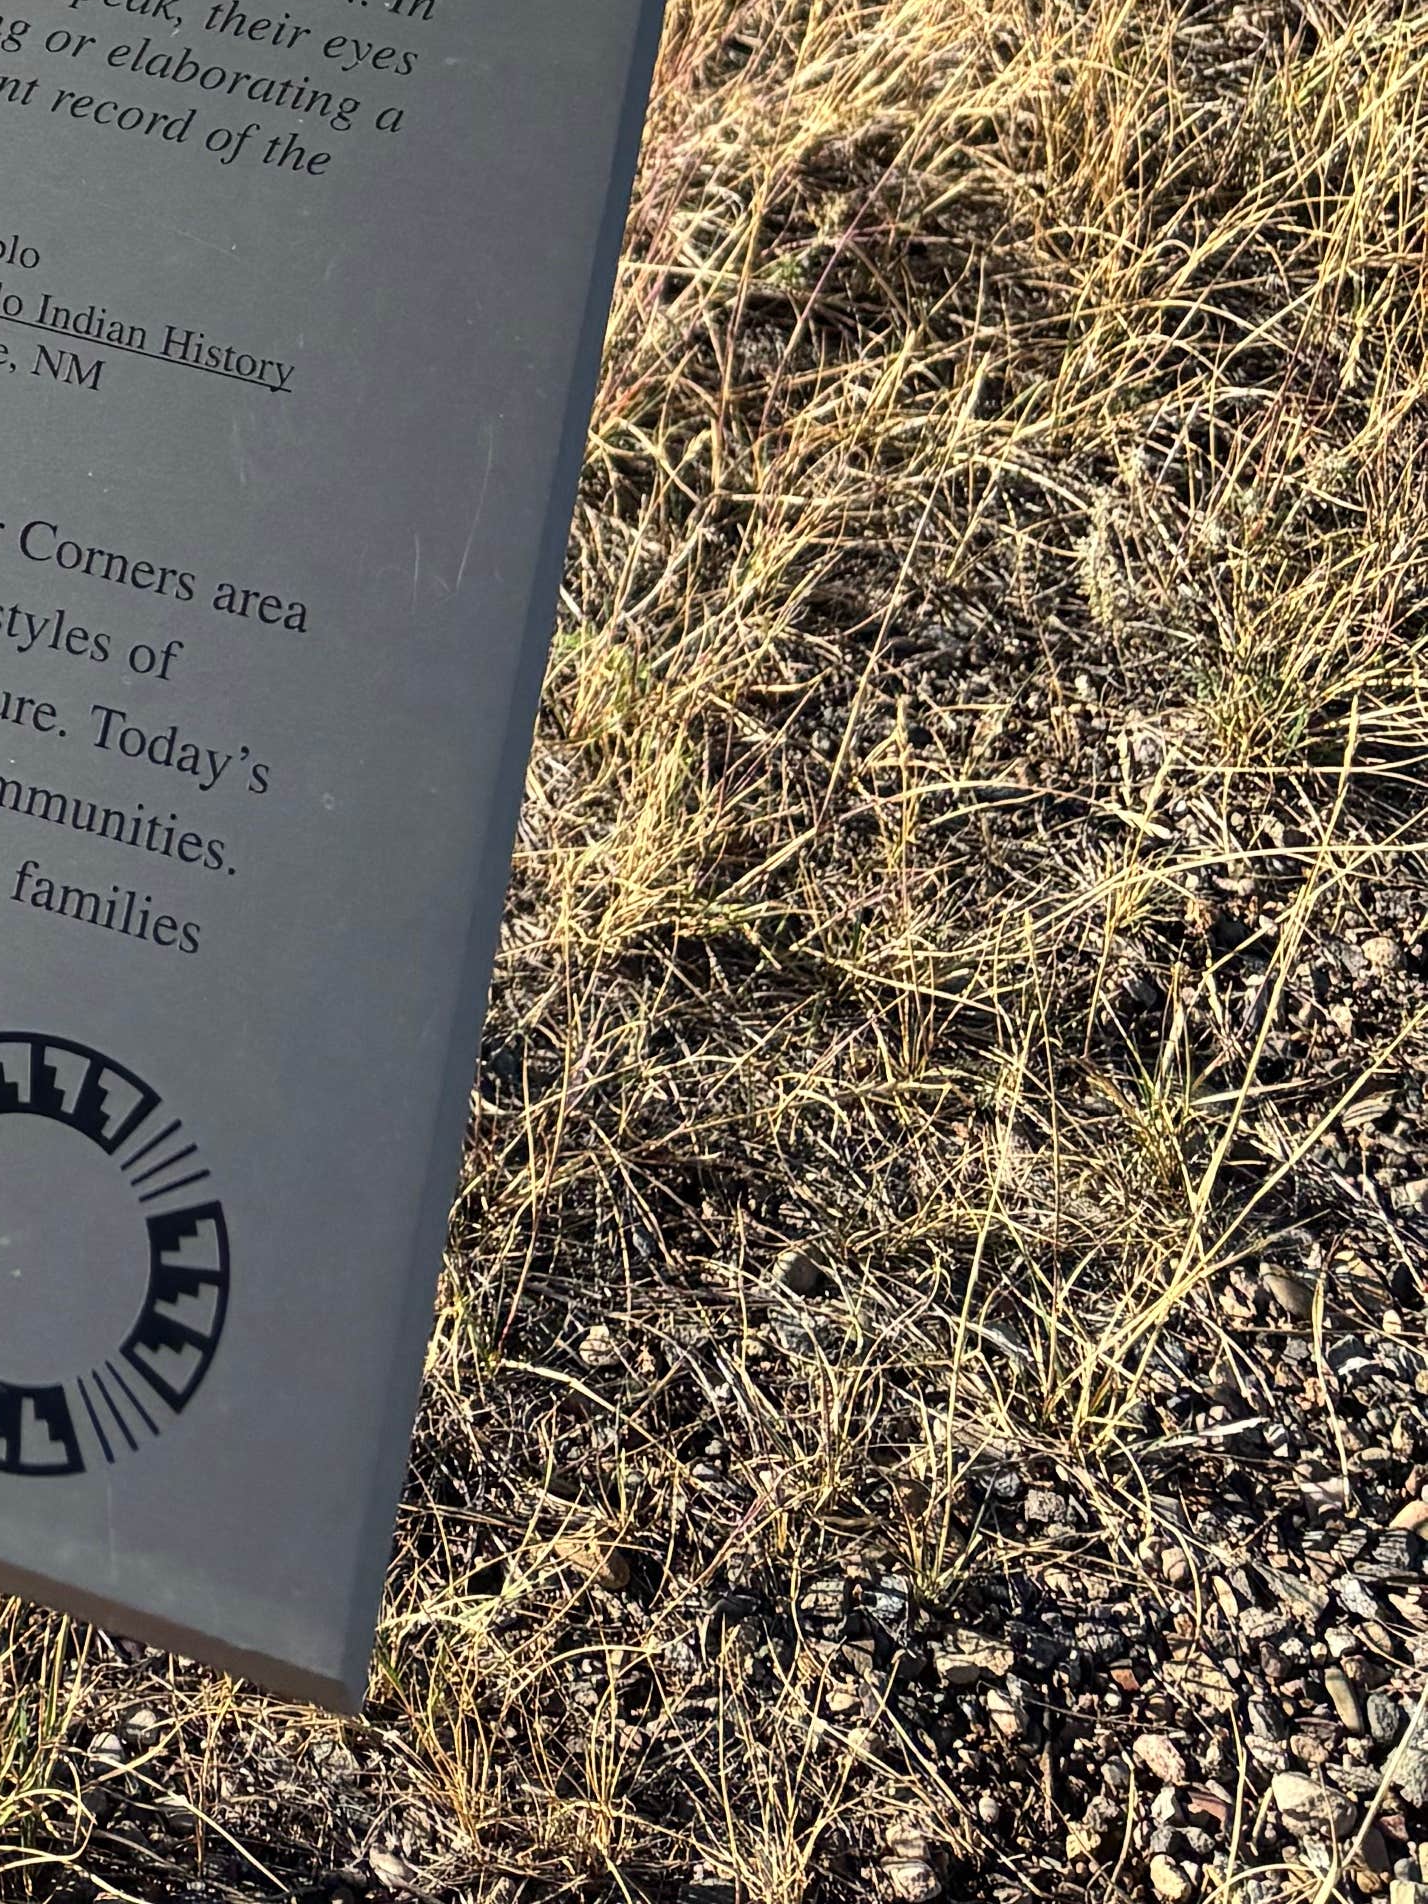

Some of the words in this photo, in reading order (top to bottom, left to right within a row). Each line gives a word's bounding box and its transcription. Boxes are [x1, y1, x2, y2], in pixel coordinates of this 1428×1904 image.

[43, 28, 97, 59] or
[105, 35, 362, 133] elaborating
[373, 105, 405, 134] a
[321, 34, 420, 77] eyes
[48, 87, 198, 144] record
[203, 121, 262, 166] of
[260, 130, 333, 177] the
[29, 342, 106, 392] NM
[34, 292, 148, 351] Indian
[158, 323, 296, 394] History
[17, 518, 197, 603] Corners
[211, 581, 308, 634] area
[126, 638, 186, 682] of
[89, 702, 271, 795] Today’s
[8, 858, 202, 955] families
